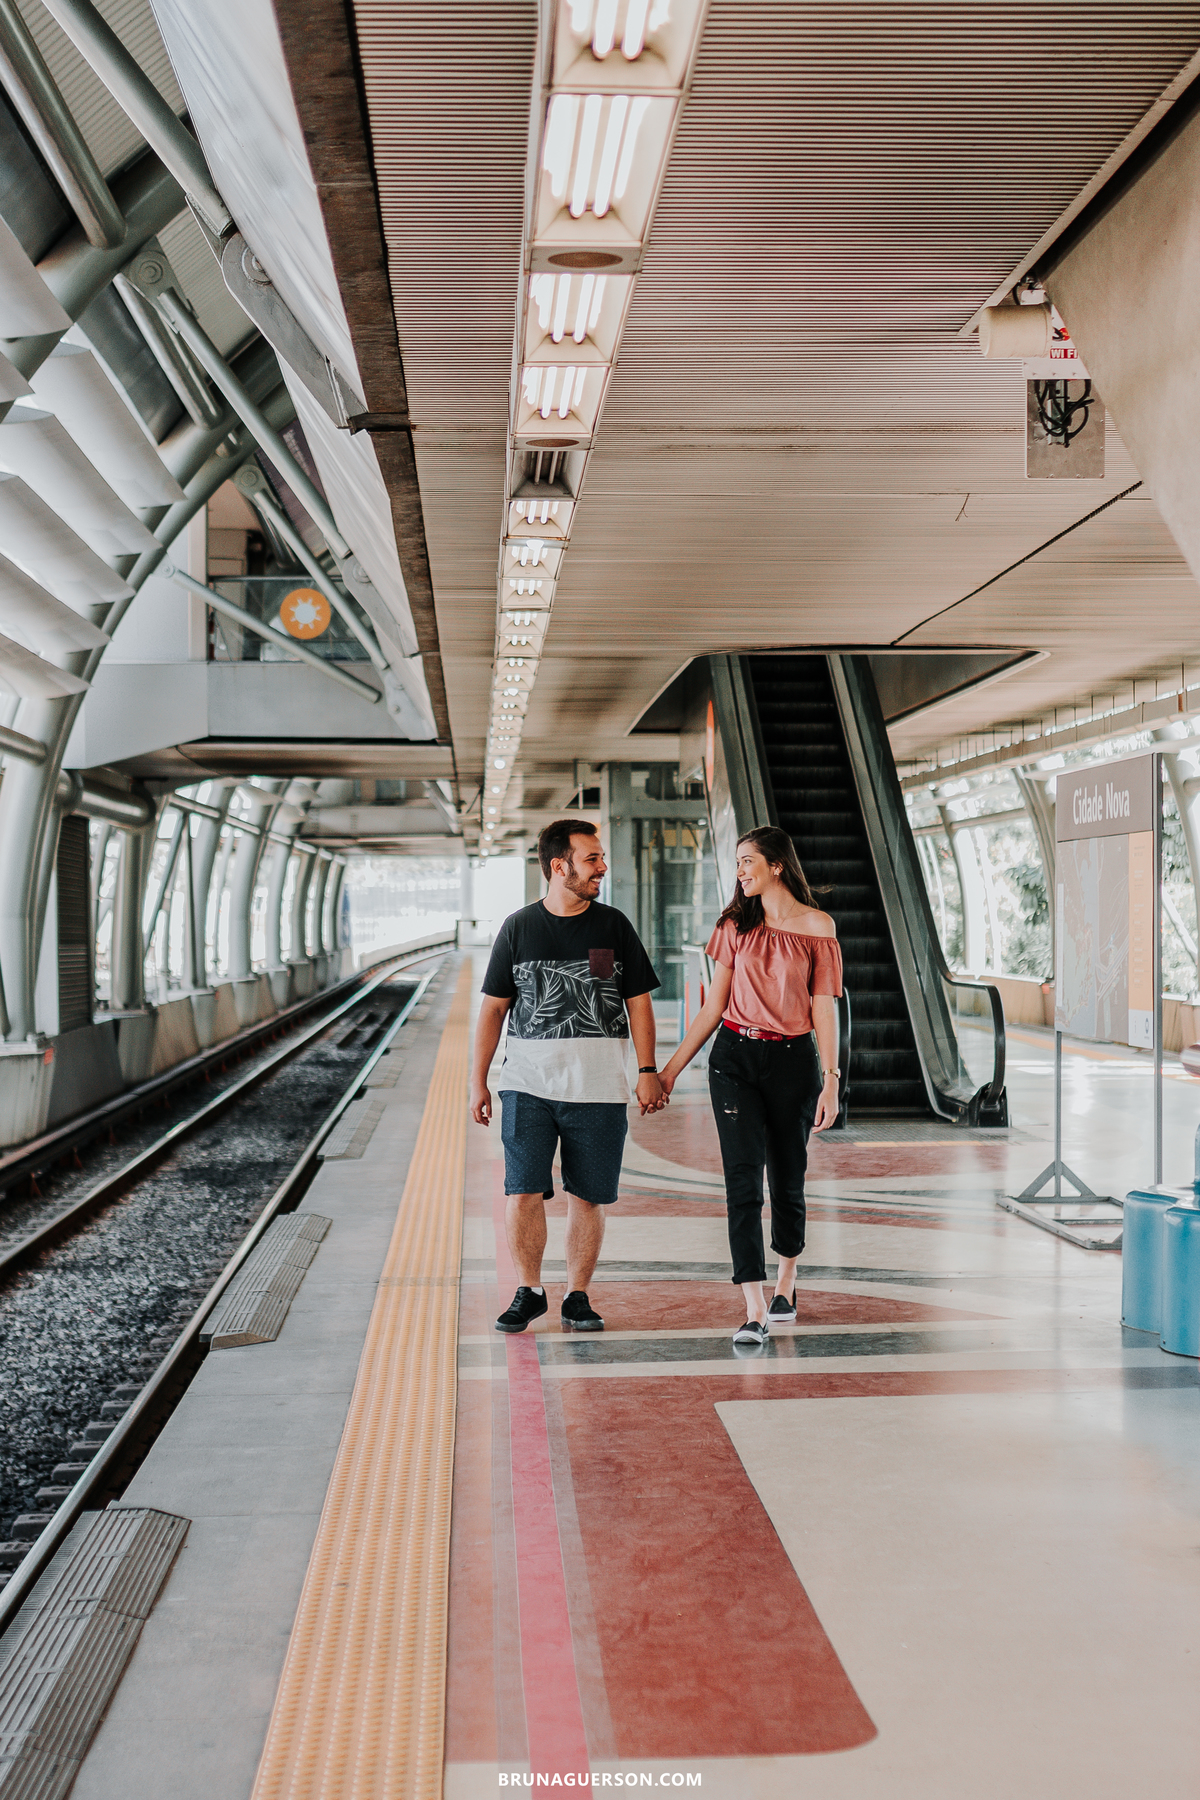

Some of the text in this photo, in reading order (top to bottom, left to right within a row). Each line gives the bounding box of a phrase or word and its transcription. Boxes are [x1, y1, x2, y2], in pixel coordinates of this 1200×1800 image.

[1051, 349, 1077, 359] WI FI
[1073, 782, 1130, 826] Cidade Nova
